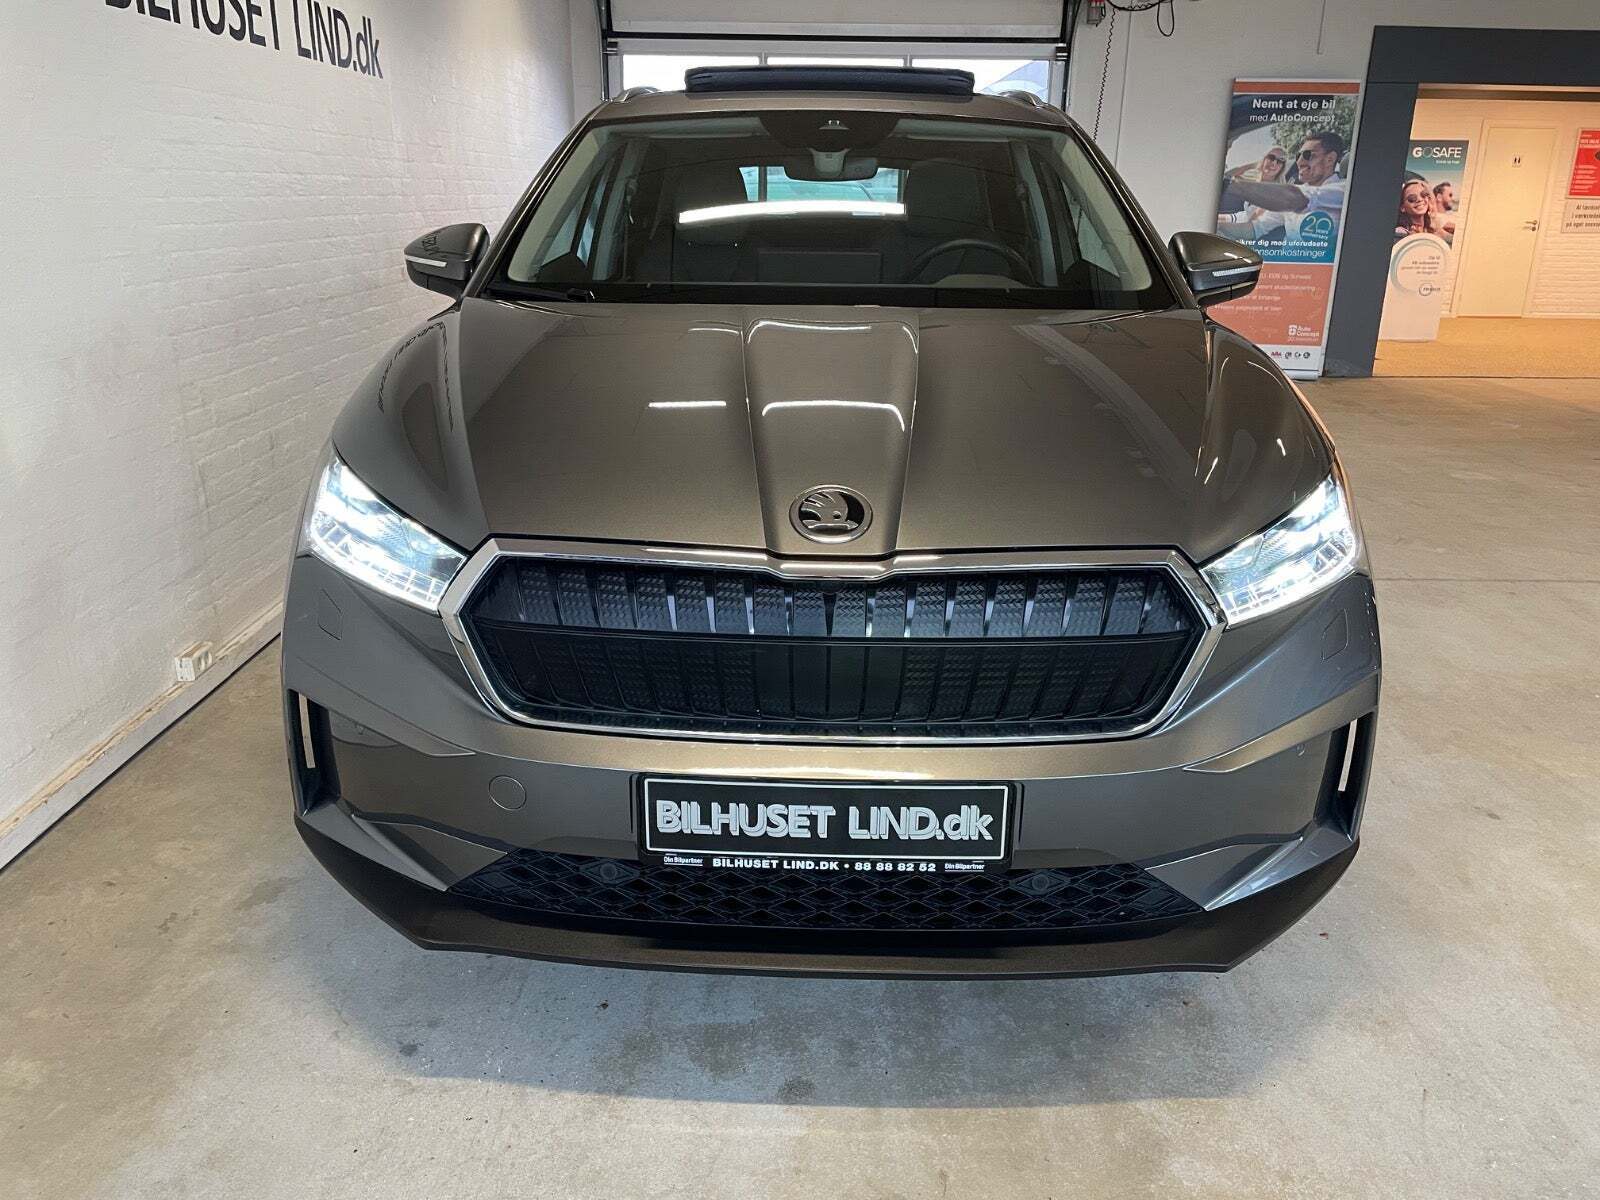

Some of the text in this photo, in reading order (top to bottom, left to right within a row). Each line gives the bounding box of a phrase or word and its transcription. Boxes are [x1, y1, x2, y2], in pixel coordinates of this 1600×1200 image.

[292, 0, 384, 79] LIND.dk
[1252, 98, 1336, 111] Nemt at eje bil
[1249, 113, 1336, 123] med AutoConcept
[1257, 239, 1270, 248] dig
[656, 799, 994, 841] BILHUSET LIND.dk
[712, 858, 937, 872] BILHUSET LIND.DK 88 88 82 52
